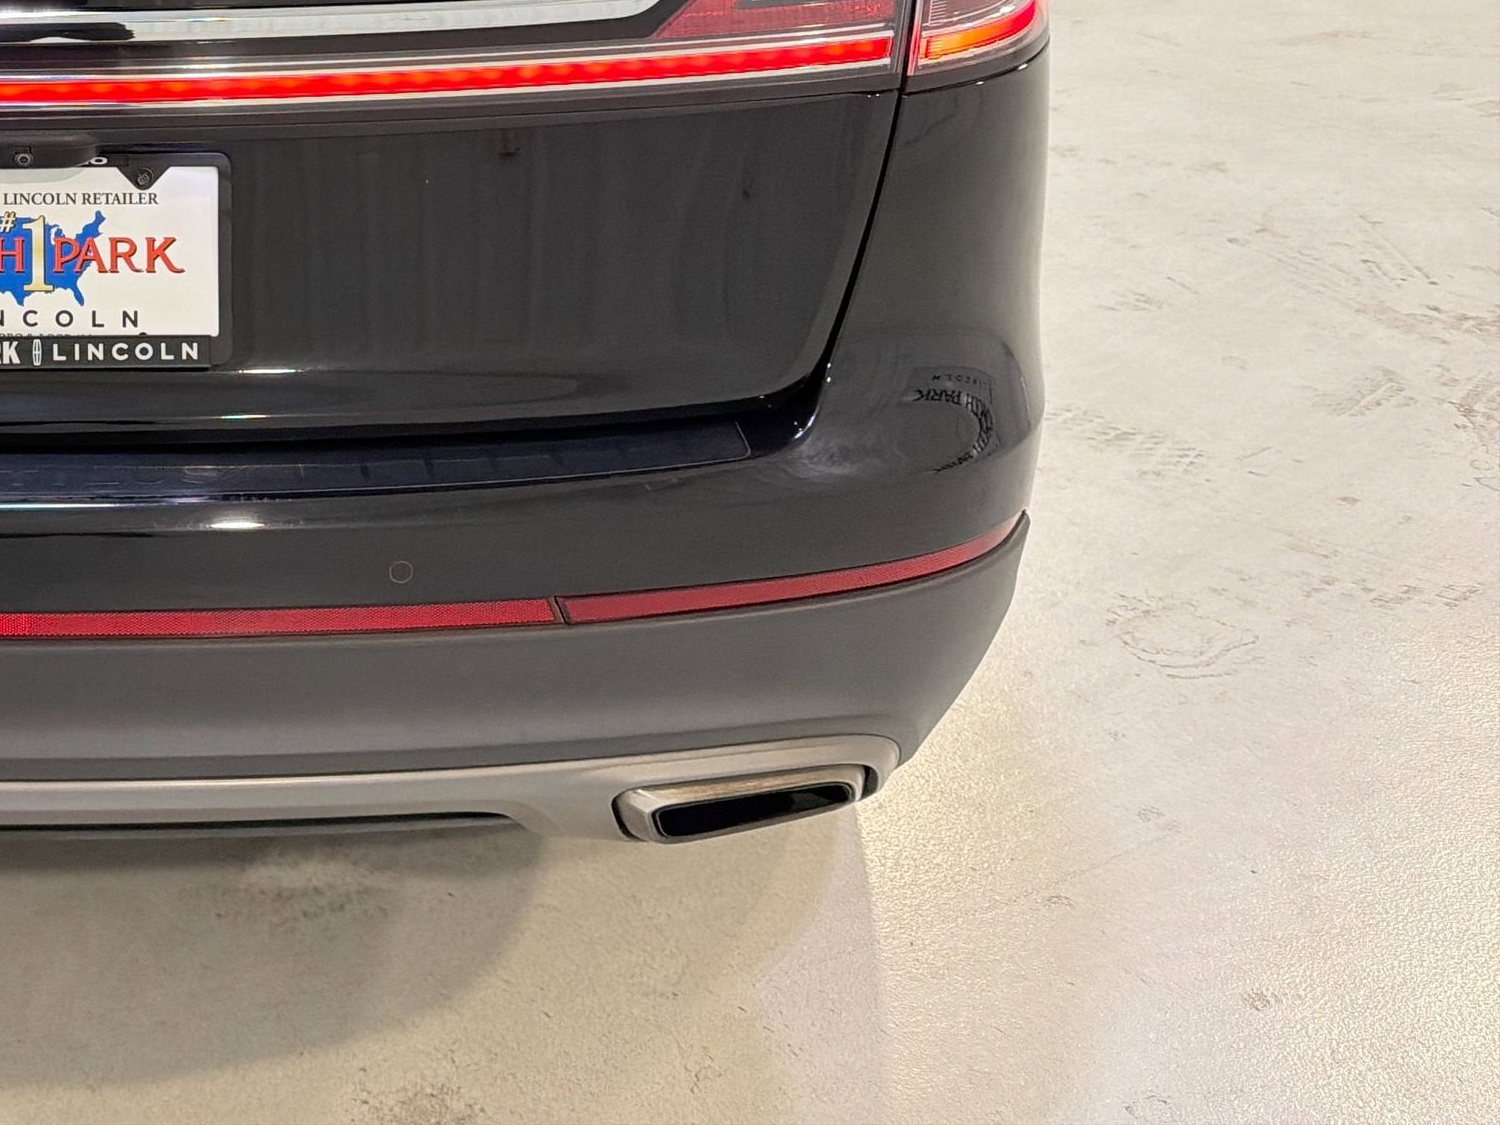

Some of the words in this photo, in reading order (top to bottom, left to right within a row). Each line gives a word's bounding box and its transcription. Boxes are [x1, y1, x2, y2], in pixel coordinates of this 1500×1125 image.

[3, 193, 76, 206] LINCOLN
[81, 193, 159, 206] RETAILER
[53, 236, 186, 274] PARK
[53, 342, 199, 362] LINCOLN
